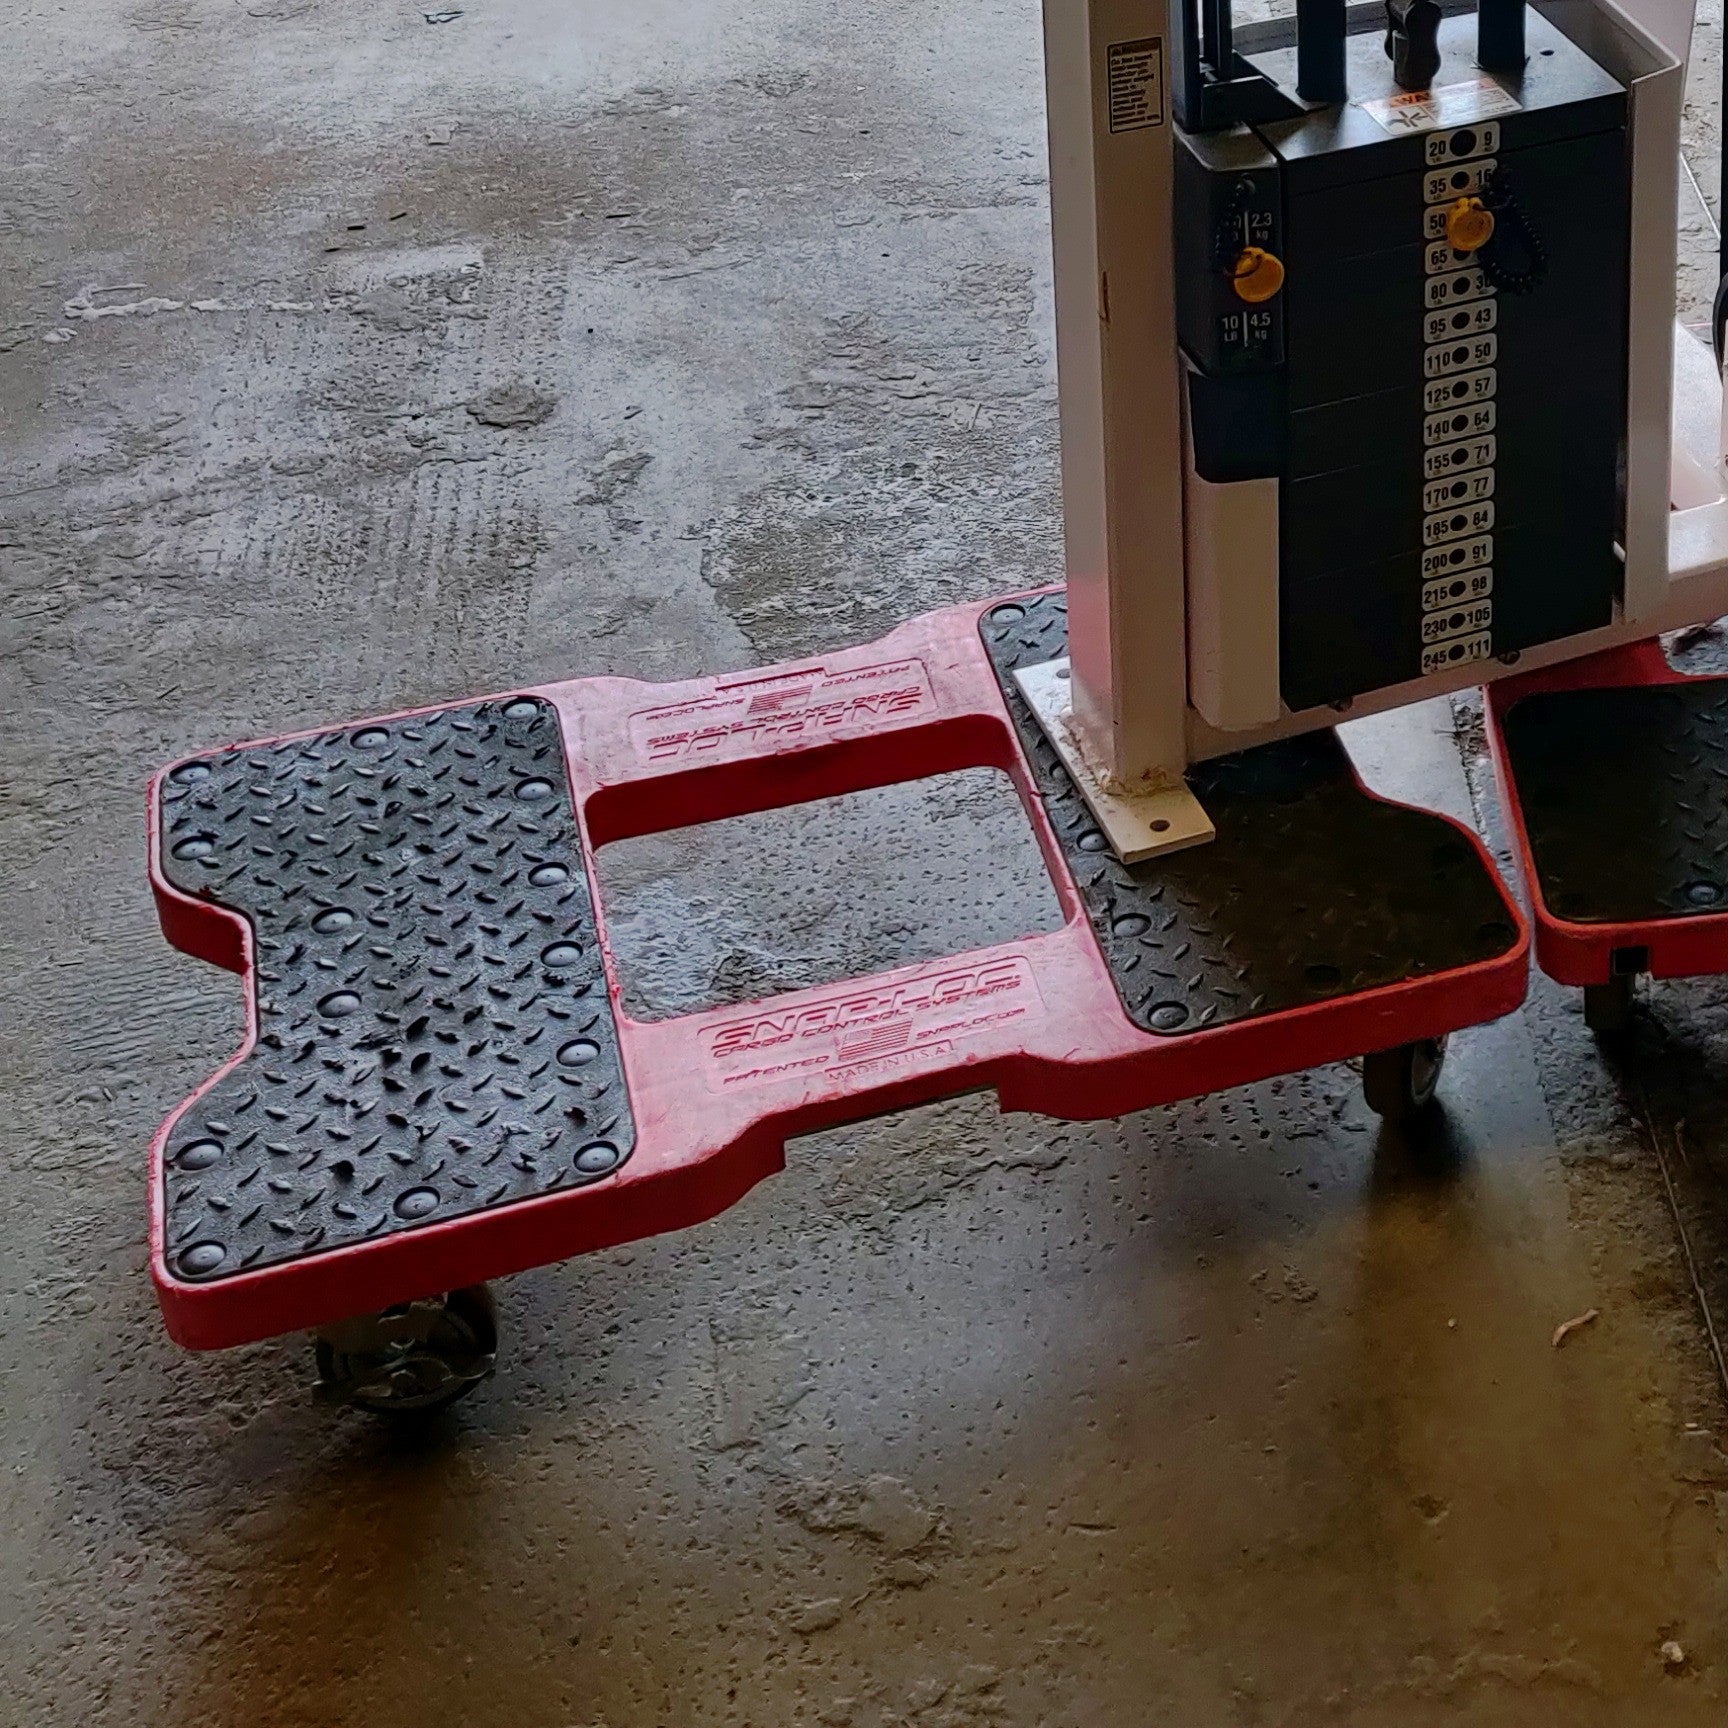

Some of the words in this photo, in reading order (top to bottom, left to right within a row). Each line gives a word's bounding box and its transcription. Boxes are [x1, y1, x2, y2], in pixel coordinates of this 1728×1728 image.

[1429, 140, 1446, 157] 20
[1484, 131, 1493, 146] 9
[1429, 178, 1446, 195] 35
[1476, 168, 1492, 184] 16
[1251, 212, 1273, 228] 2.3
[1430, 213, 1447, 230] 50
[1431, 249, 1448, 266] 65
[1431, 282, 1447, 300] 80
[1222, 315, 1239, 331] 10
[1250, 311, 1272, 328] 4.5
[1430, 318, 1446, 335] 95
[1475, 307, 1491, 324] 43
[1427, 352, 1450, 370] 110
[1475, 342, 1491, 359] 50
[1427, 387, 1450, 404] 125
[1475, 377, 1491, 393] 57
[1426, 420, 1449, 438] 140
[1474, 410, 1490, 426] 64
[1426, 453, 1450, 471] 155
[1474, 444, 1490, 459] 71
[1426, 486, 1449, 504] 170
[1473, 477, 1489, 493] 77
[1426, 520, 1448, 538] 185
[1473, 510, 1488, 526] 84
[1424, 553, 1447, 572] 200
[1472, 543, 1487, 559] 91
[1424, 586, 1448, 604] 215
[1472, 576, 1487, 591] 98
[1424, 618, 1447, 636] 230
[1467, 607, 1490, 624] 105
[1424, 650, 1447, 668] 245
[1467, 639, 1489, 655] 111
[853, 686, 920, 705] CARGO
[750, 701, 846, 723] CONTROL
[646, 721, 744, 744] SYSTEMS
[711, 962, 1020, 1050] SNAP-LOC
[713, 1032, 794, 1058] CARGO
[801, 1009, 912, 1038] CONTROL
[916, 980, 1020, 1010] SYSTEMS
[723, 1055, 830, 1084] PATENTED
[828, 1059, 880, 1081] MADE
[881, 1055, 901, 1072] IN
